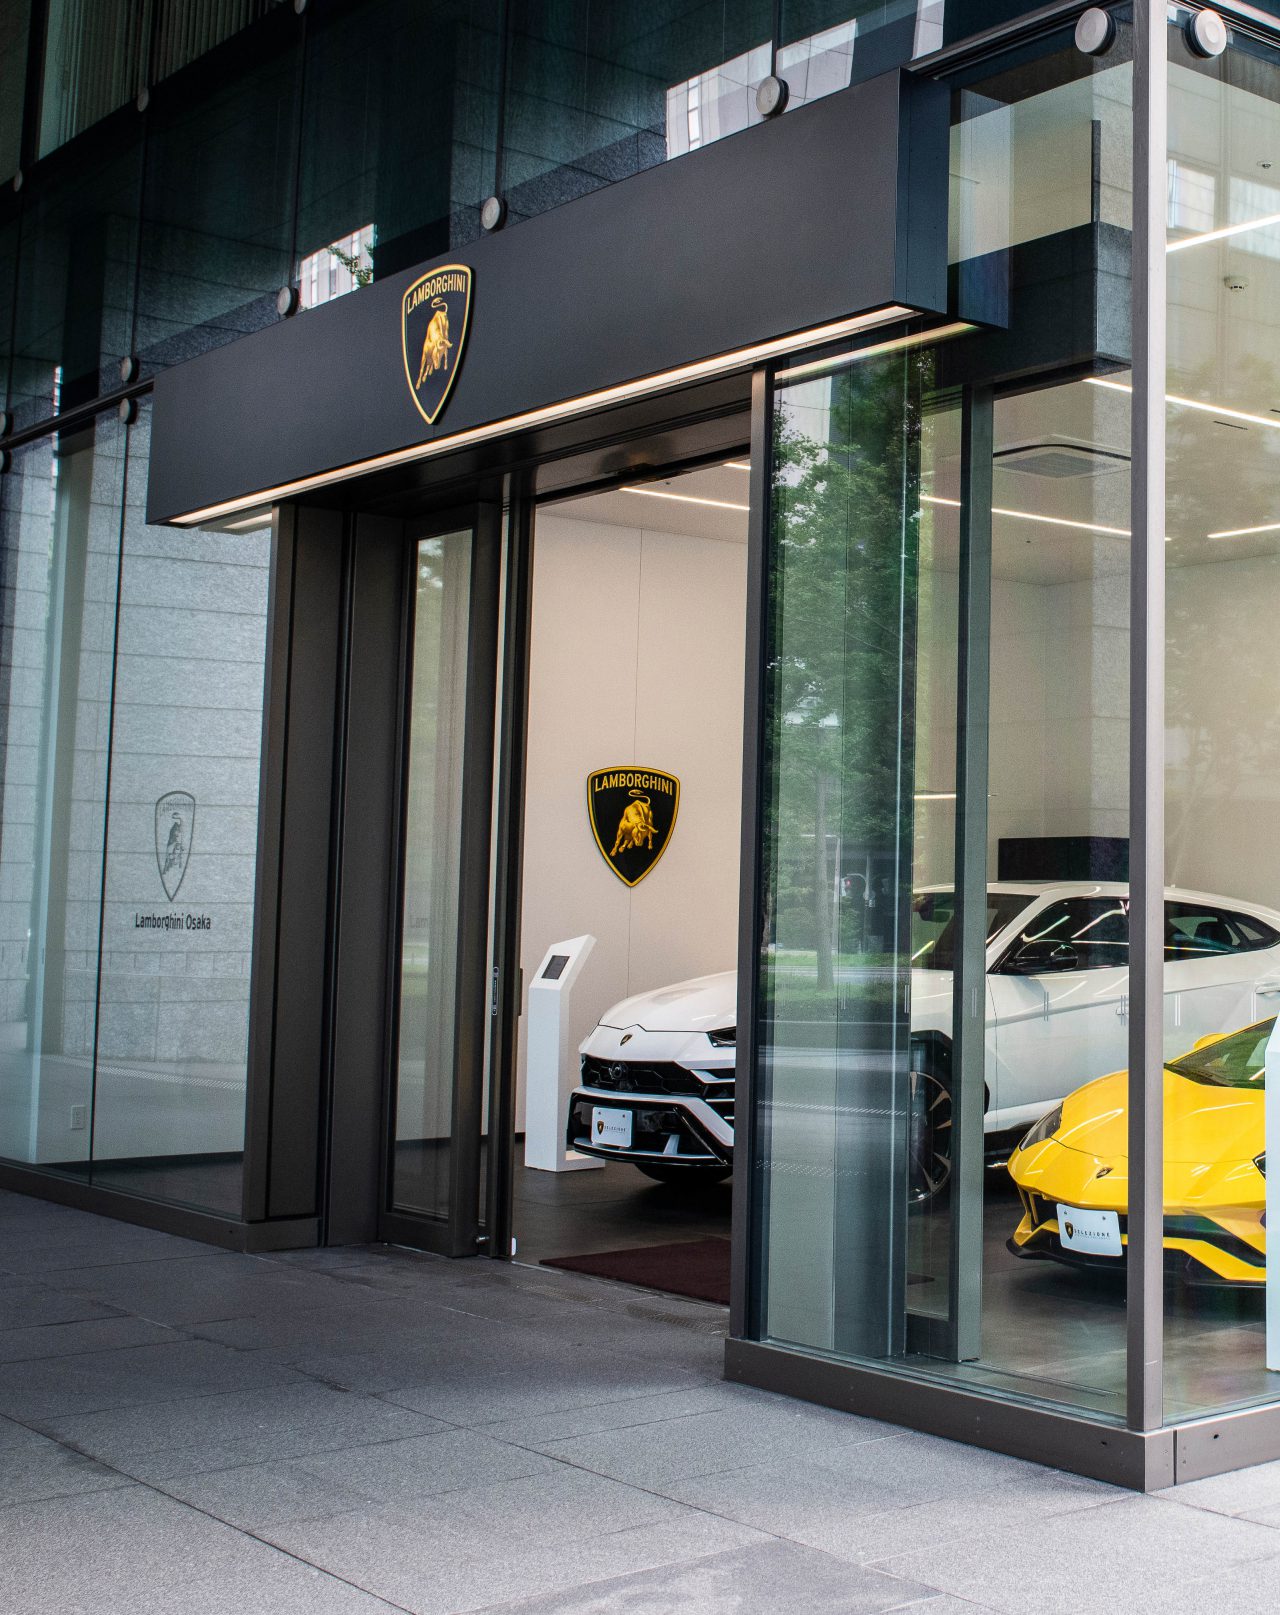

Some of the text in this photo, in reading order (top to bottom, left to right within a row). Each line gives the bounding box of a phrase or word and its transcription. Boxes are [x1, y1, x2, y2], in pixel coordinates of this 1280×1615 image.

[407, 274, 466, 314] LAMBORGHINI
[595, 773, 673, 796] LAMBORGHINI
[135, 912, 211, 932] Lamborghini Osaka
